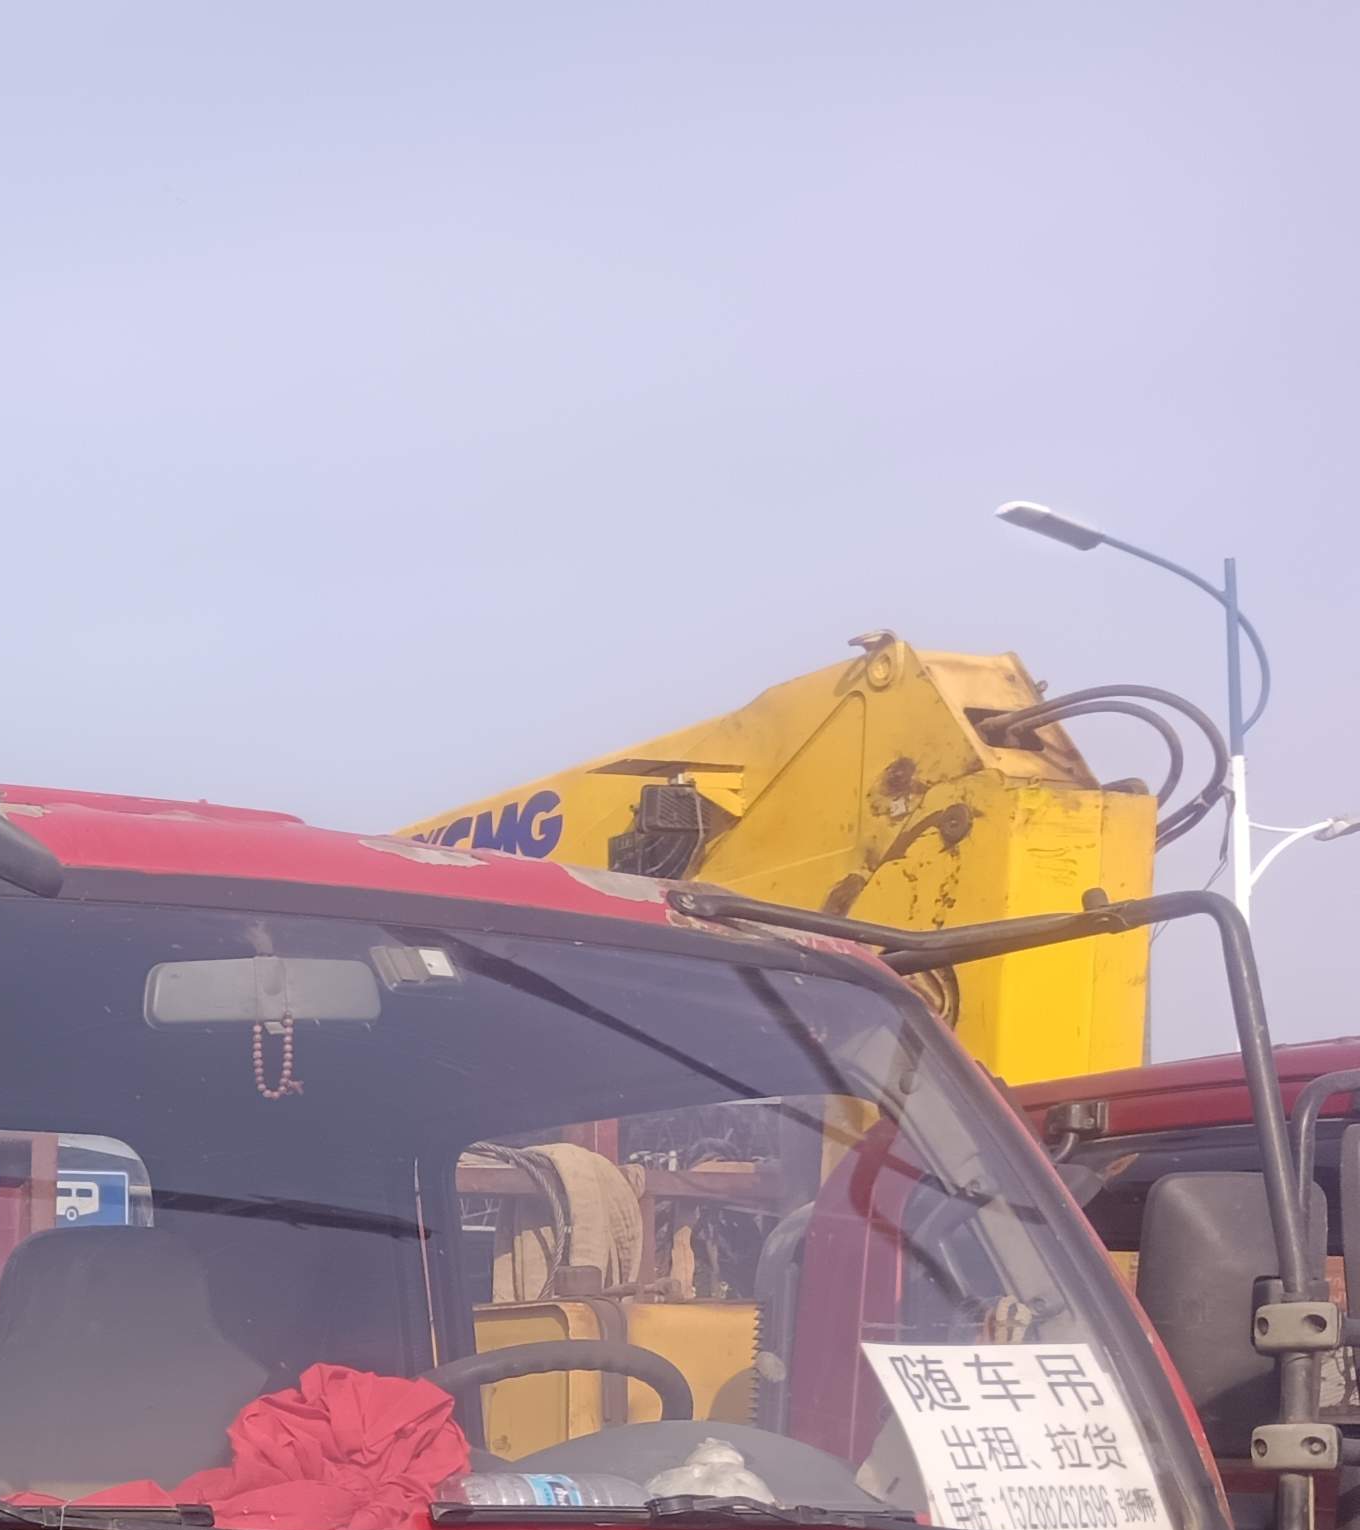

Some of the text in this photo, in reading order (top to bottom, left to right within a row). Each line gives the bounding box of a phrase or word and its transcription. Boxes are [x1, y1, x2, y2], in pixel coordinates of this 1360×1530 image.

[888, 1353, 1105, 1413] 随车吊
[941, 1423, 1128, 1472] 出租、拉货
